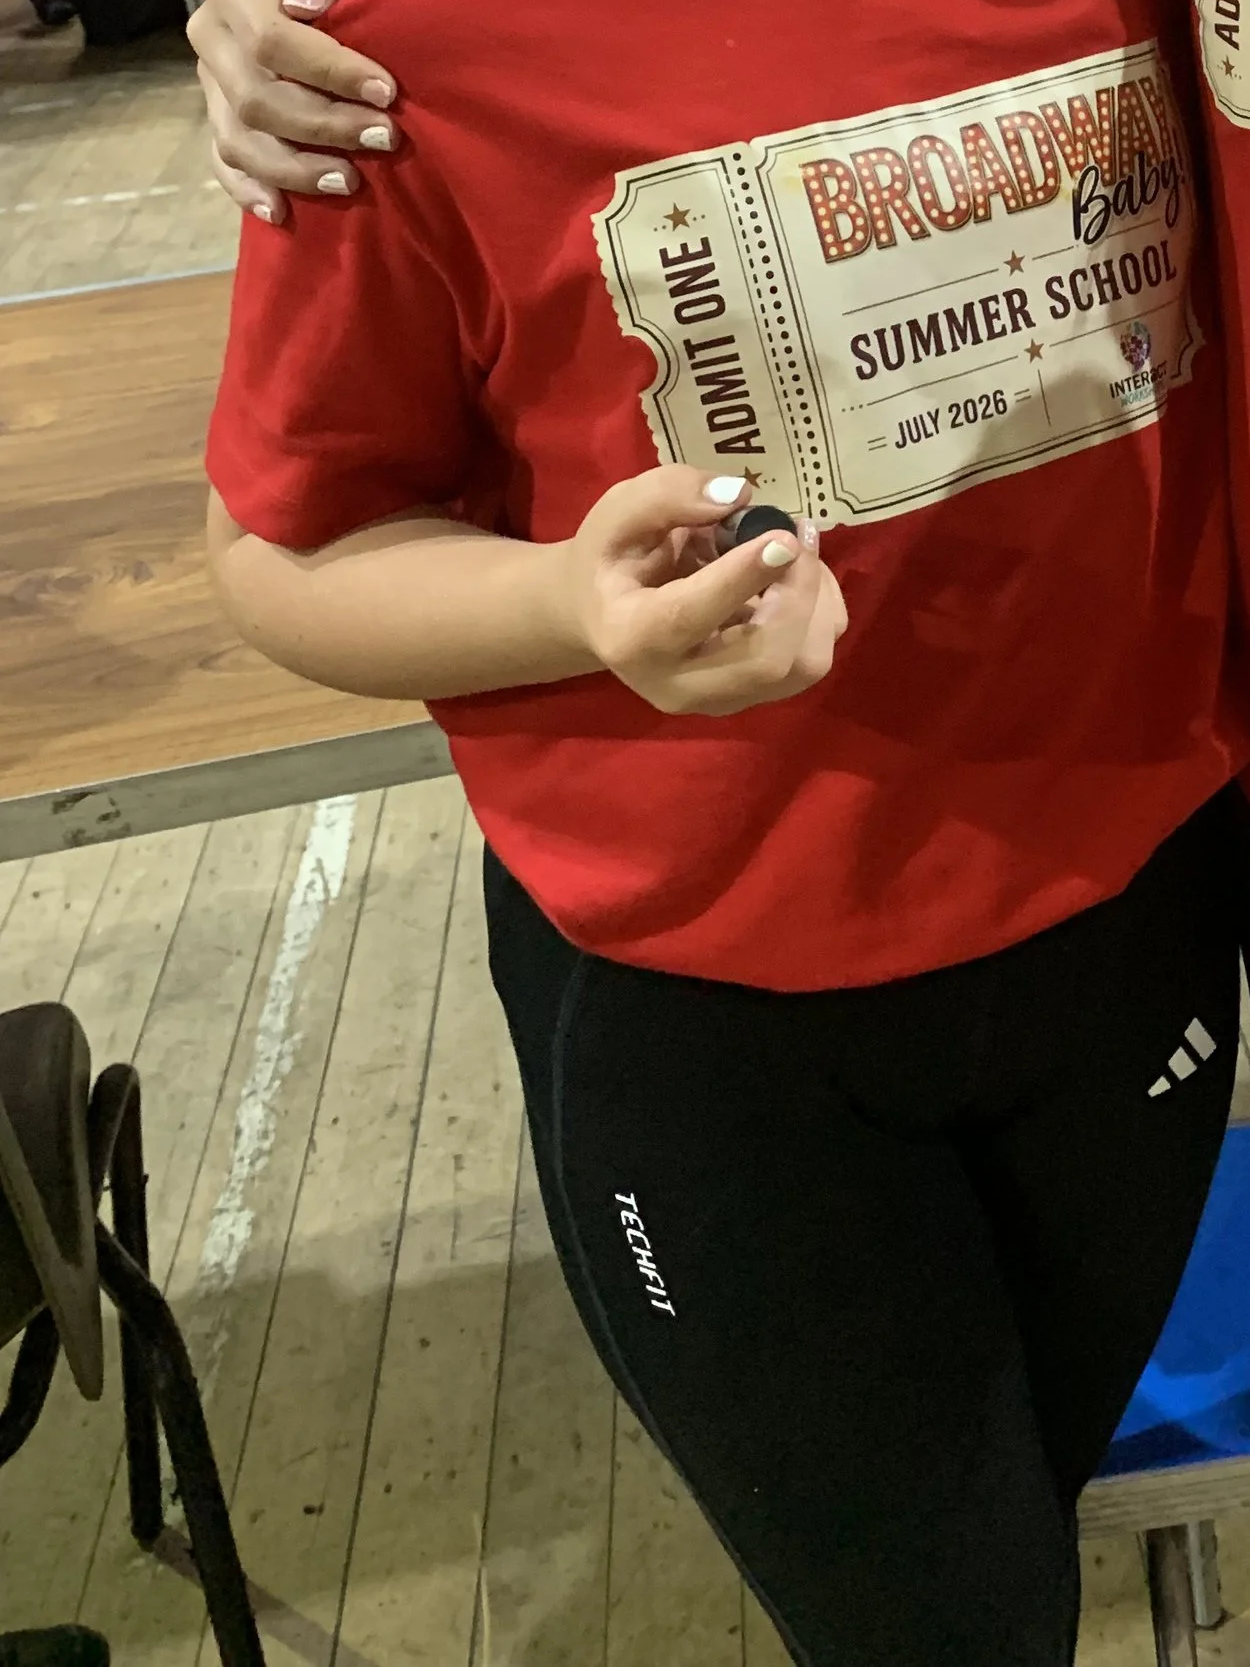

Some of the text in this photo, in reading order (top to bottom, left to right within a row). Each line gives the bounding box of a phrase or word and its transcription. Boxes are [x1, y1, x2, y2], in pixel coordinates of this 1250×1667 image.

[798, 76, 1171, 264] BROADWAY
[660, 236, 767, 454] ADMIT ONE
[850, 239, 1178, 381] SUMMER SCHOOL
[894, 389, 1008, 450] JULY 2026
[615, 1192, 676, 1316] TECHFIT
